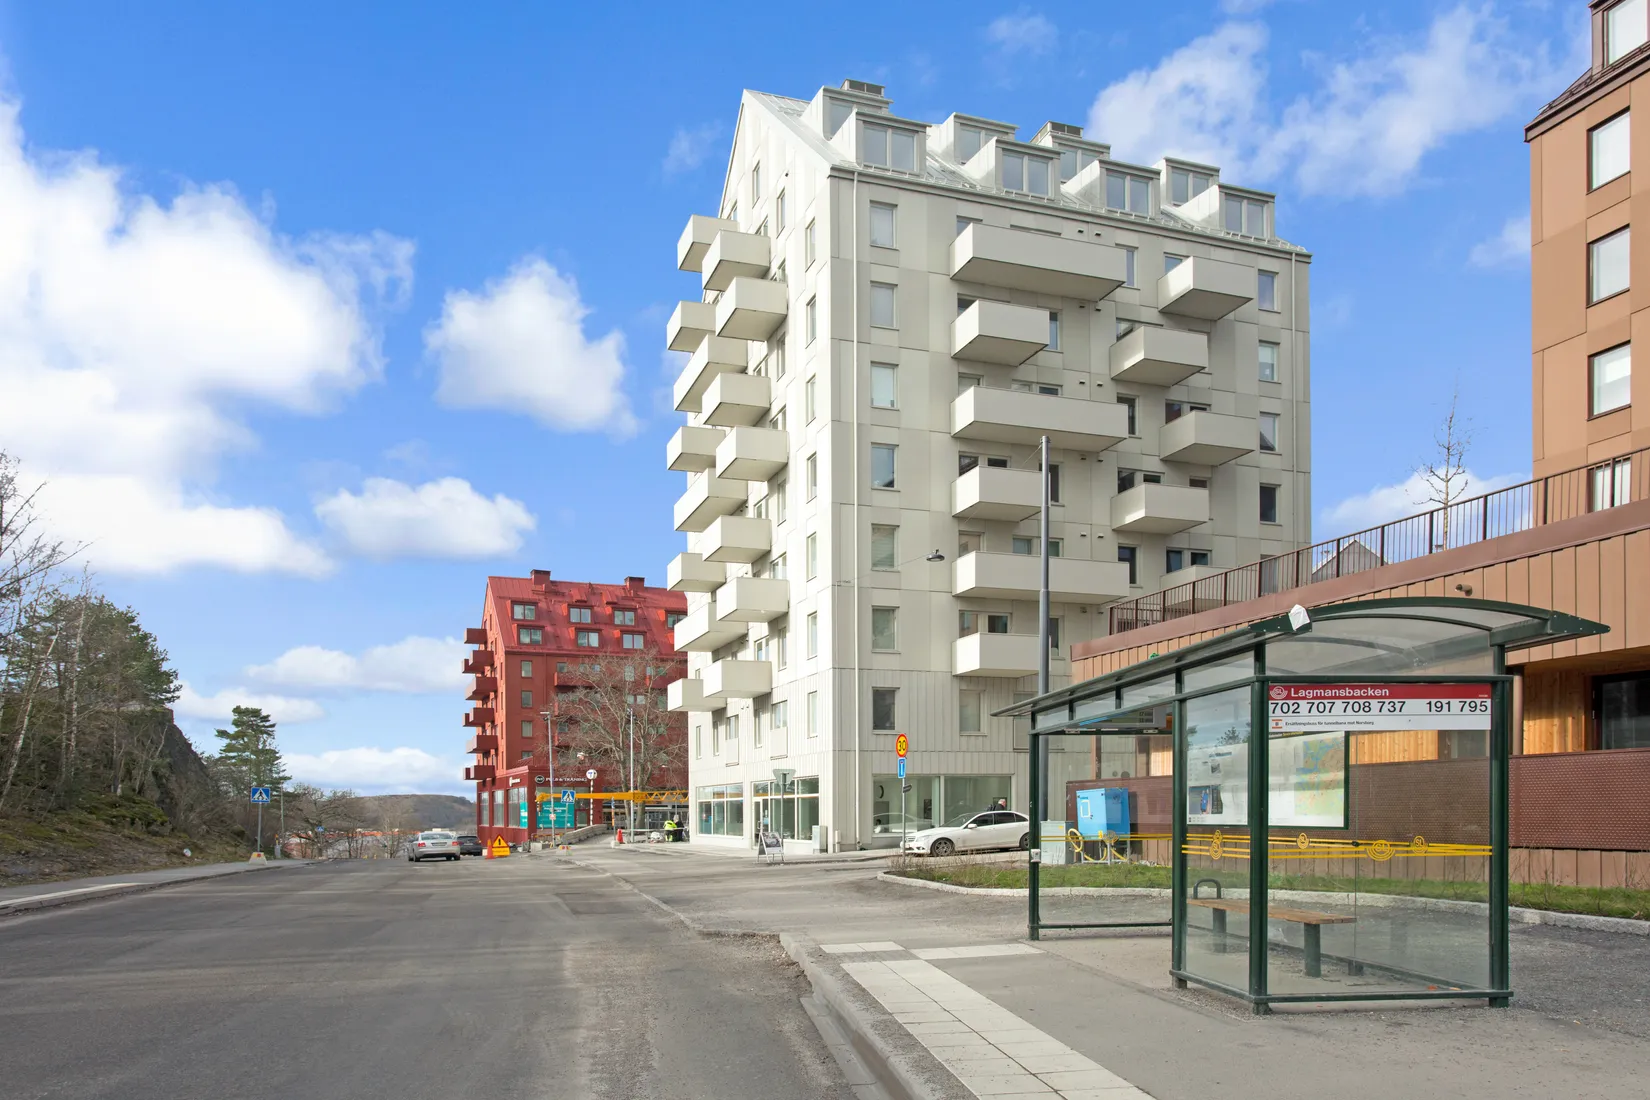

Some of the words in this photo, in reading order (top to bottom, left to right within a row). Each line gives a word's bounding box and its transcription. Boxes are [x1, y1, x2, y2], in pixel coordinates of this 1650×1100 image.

[1291, 687, 1389, 698] Lagmansbacken
[1270, 702, 1301, 714] 702
[1306, 701, 1336, 714] 707
[1341, 701, 1372, 713] 708
[1377, 701, 1406, 713] 737
[1426, 701, 1451, 713] 191
[1459, 701, 1488, 713] 795
[899, 740, 906, 751] 30
